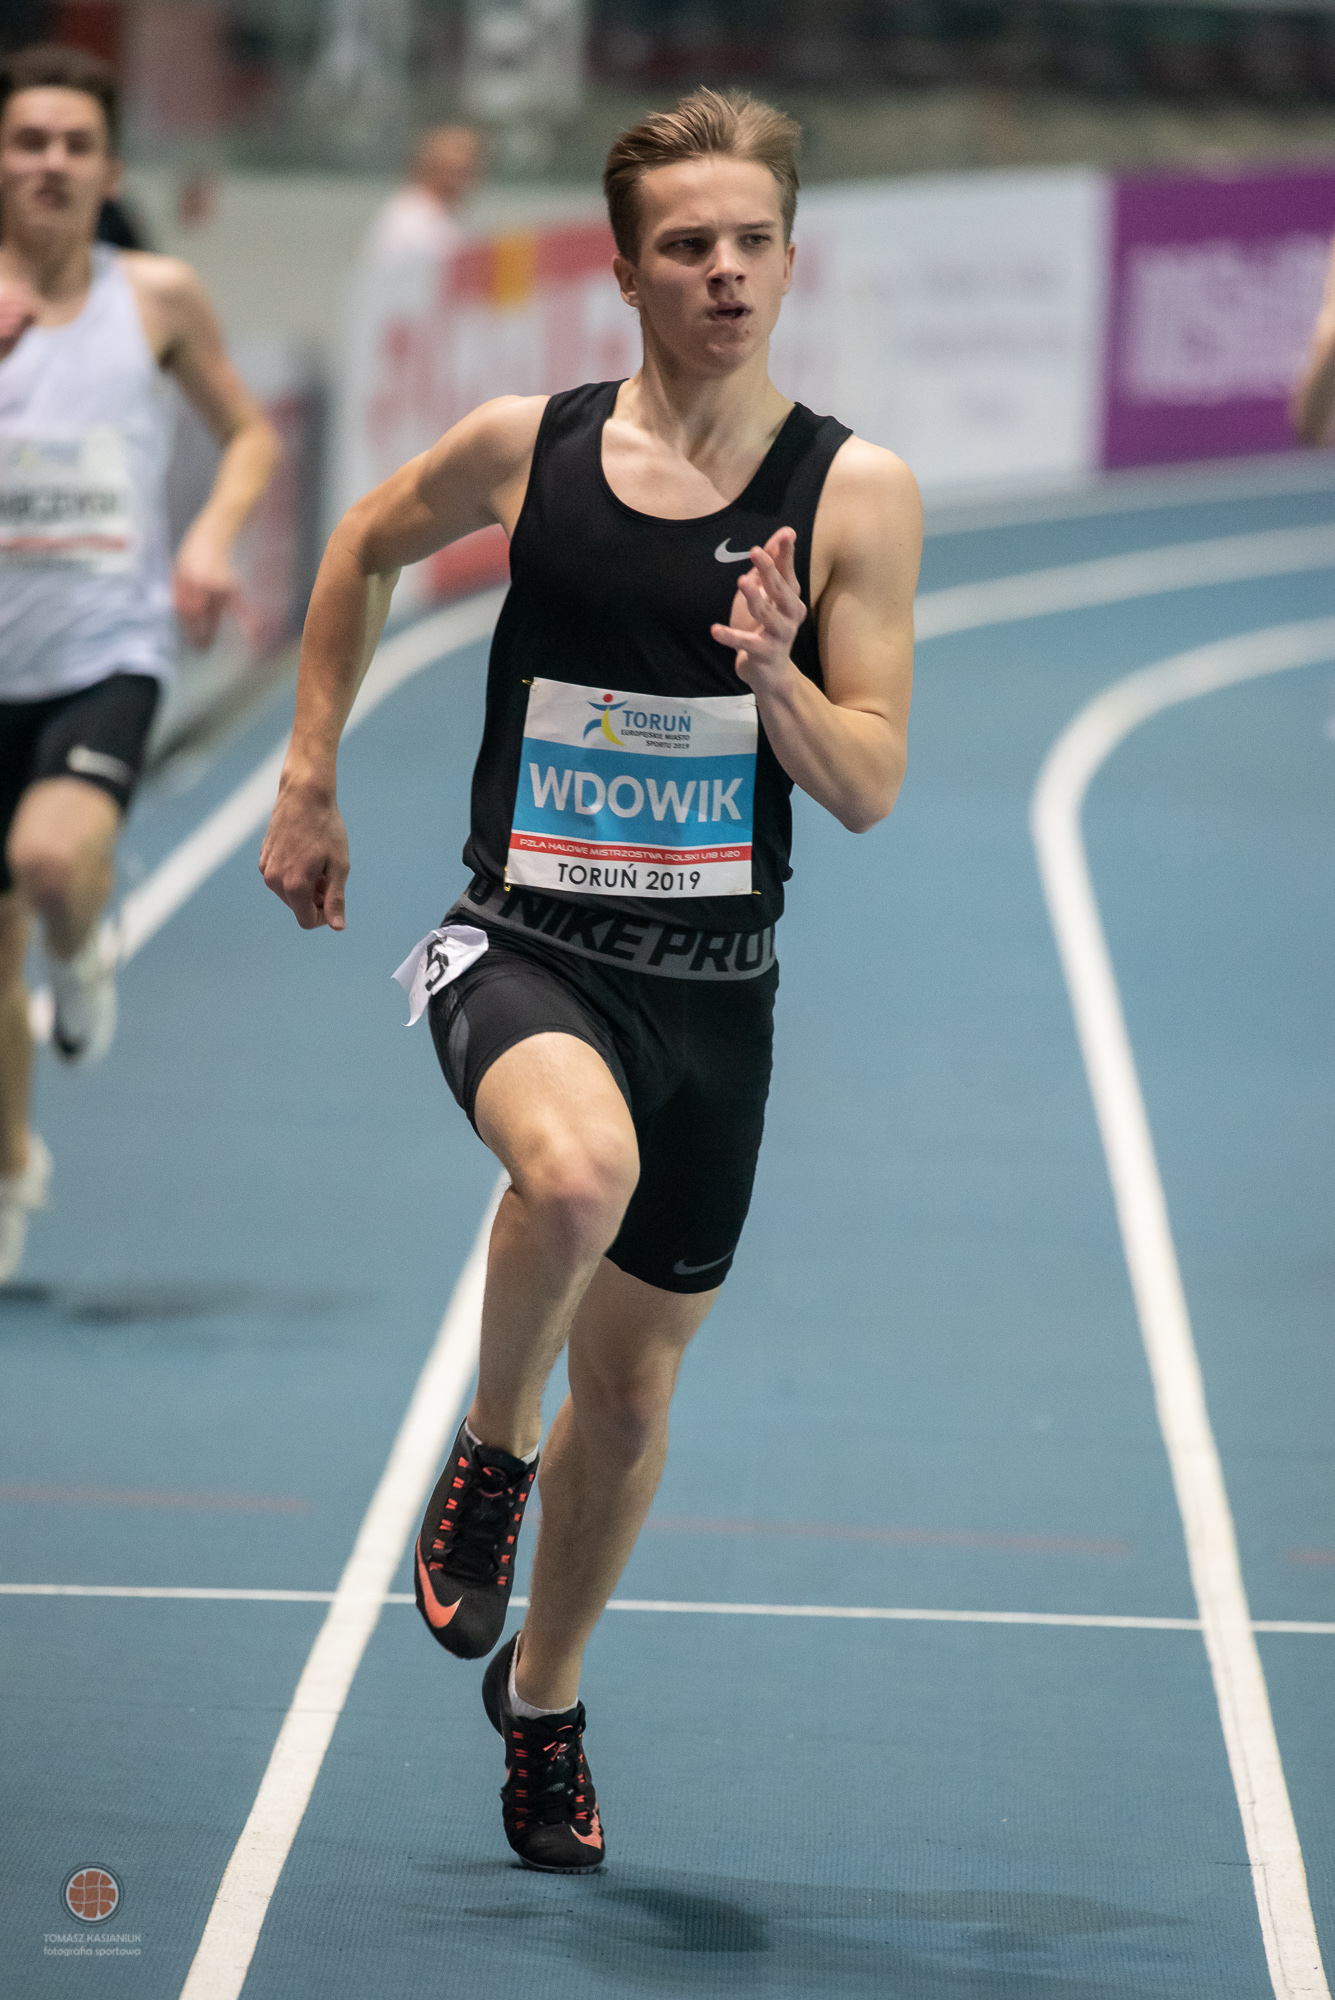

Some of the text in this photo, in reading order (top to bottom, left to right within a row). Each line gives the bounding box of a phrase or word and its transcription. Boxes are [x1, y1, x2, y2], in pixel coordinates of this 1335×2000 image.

[622, 709, 691, 732] TORUŃ
[645, 740, 672, 749] SPORTU
[665, 733, 691, 741] MIASTO
[528, 762, 743, 823] WDOWIK
[519, 837, 741, 862] PZLA HALOWE MISTRZOSTWA POLSKI U18 U20
[558, 863, 701, 891] TORUŃ 2019
[497, 891, 650, 962] NIKE
[647, 922, 765, 972] PRO
[425, 935, 449, 992] 5
